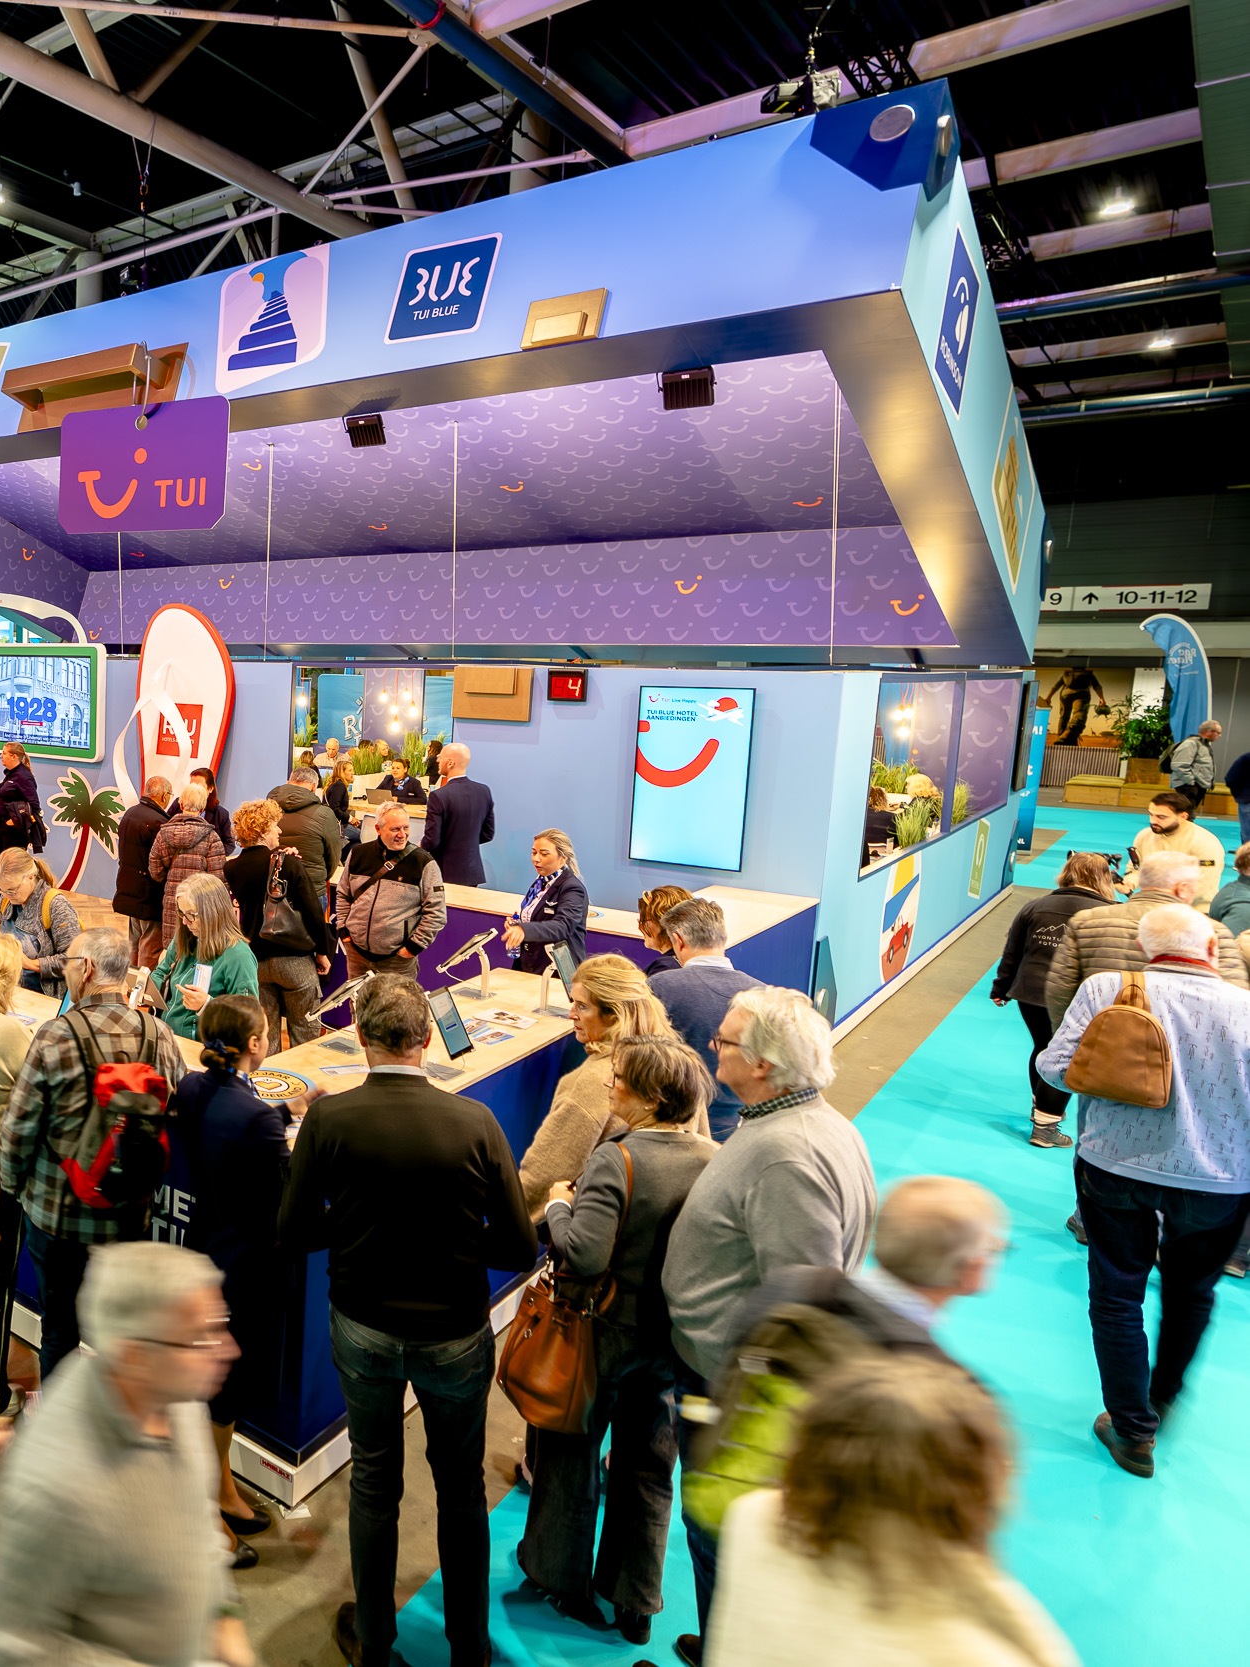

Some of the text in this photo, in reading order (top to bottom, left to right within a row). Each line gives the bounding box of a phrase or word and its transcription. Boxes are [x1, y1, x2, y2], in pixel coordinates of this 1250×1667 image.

[413, 304, 460, 321] TUI BLUE
[940, 334, 963, 391] ROBINSON
[154, 476, 206, 508] TUI
[1050, 590, 1197, 605] 9 10-11-12
[568, 678, 581, 697] 4
[7, 696, 57, 723] 1928
[162, 717, 197, 737] RU
[1032, 934, 1062, 942] AVONTU
[263, 1070, 291, 1080] JAAR
[260, 1086, 302, 1098] DERLAND
[154, 1184, 197, 1224] ME
